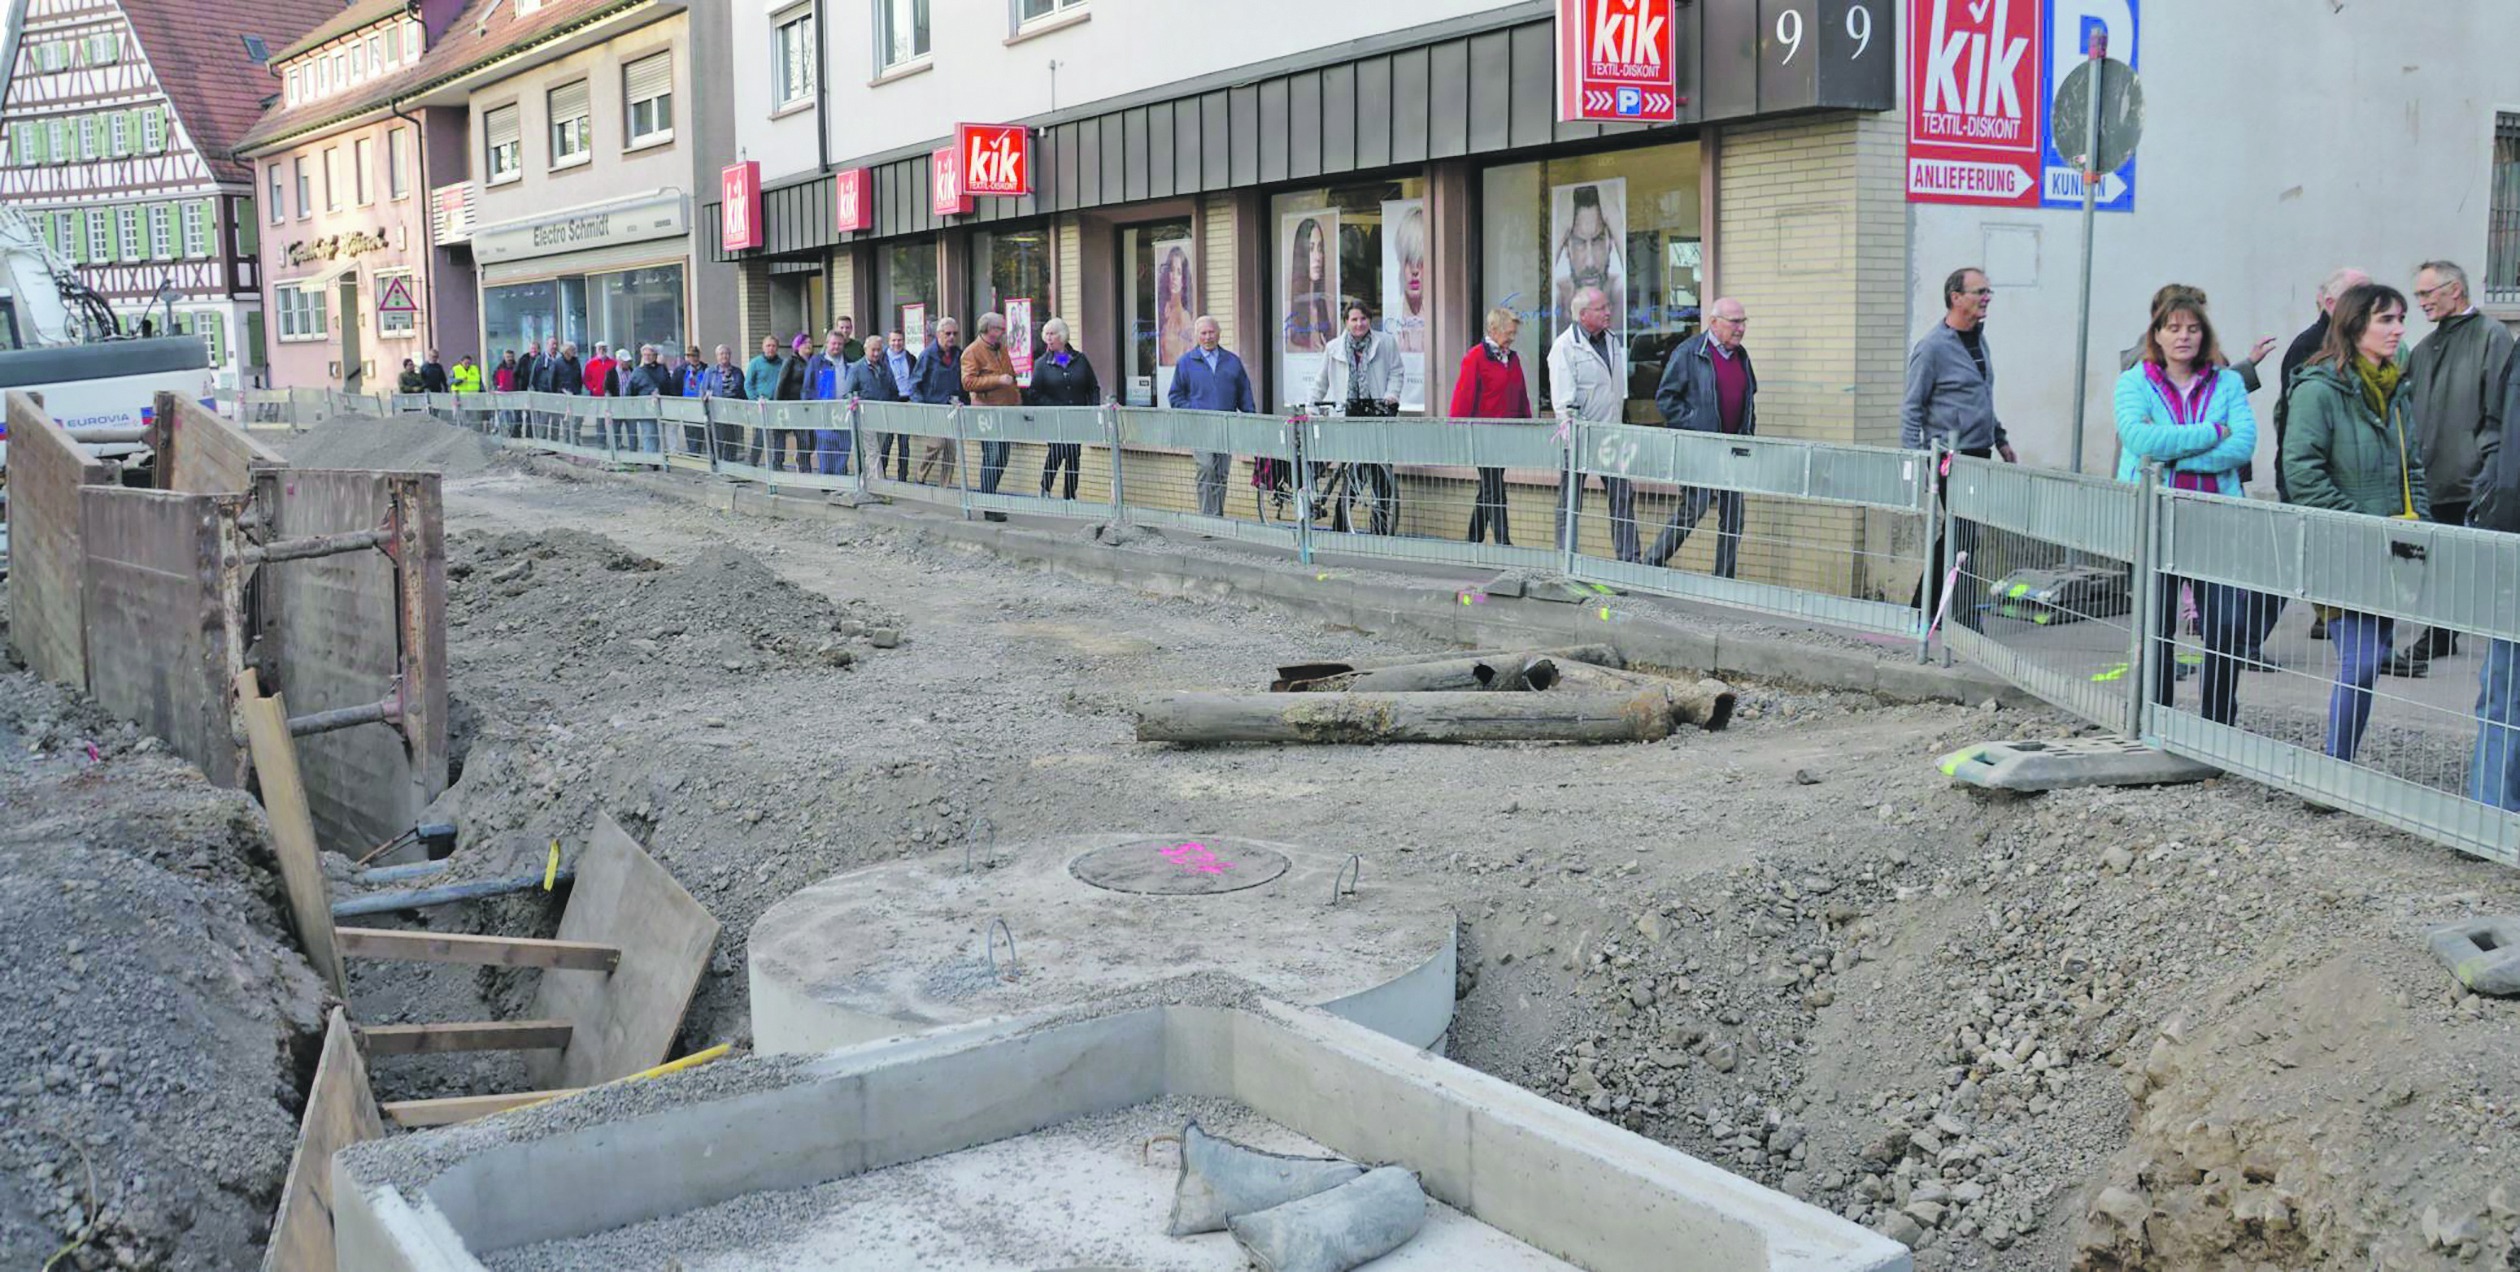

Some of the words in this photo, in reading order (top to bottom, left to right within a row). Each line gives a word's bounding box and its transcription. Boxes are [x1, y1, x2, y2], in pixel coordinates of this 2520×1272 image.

[1592, 0, 1666, 64] kik
[1776, 9, 1803, 66] 9
[1846, 5, 1872, 60] 9
[1592, 62, 1660, 78] TEXTIL-DISKONT
[1923, 0, 2029, 119] kik
[1619, 90, 1639, 113] P
[1922, 112, 2021, 140] TEXTIL-DISKONT
[969, 131, 1021, 182] kik
[936, 155, 957, 202] kik
[1914, 164, 2015, 192] ANLIEFERUNG
[2052, 172, 2106, 197] KUNN
[726, 174, 746, 234] kik
[840, 177, 857, 223] kik
[533, 225, 566, 247] Electro
[568, 213, 610, 241] Schmidt
[67, 413, 130, 428] EUROVIA
